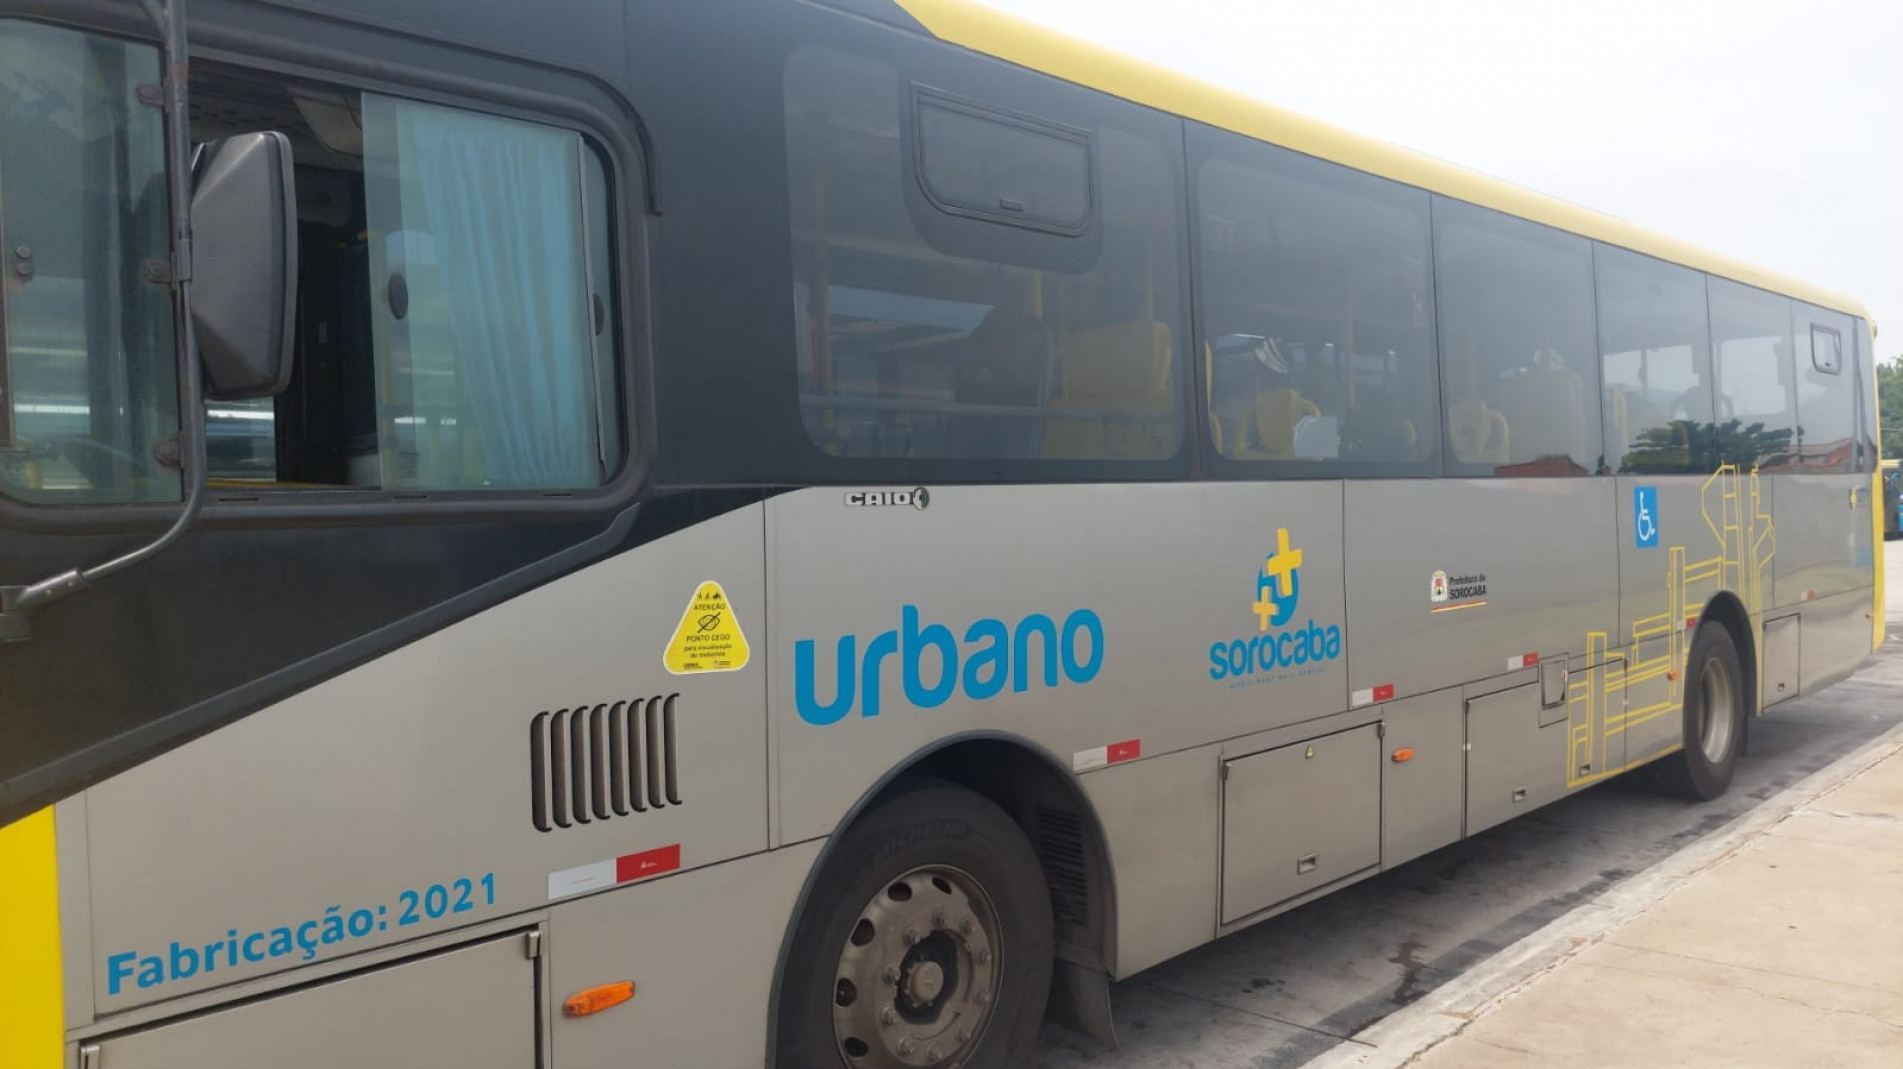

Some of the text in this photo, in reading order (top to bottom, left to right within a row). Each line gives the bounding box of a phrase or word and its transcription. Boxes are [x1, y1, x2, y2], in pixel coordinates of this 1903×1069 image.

[844, 491, 911, 506] CAIO
[1449, 584, 1487, 599] SOROCABA
[686, 633, 731, 642] PONTO CEGO
[1209, 619, 1341, 680] sorocaba
[795, 604, 1104, 726] urbano
[107, 872, 495, 995] Fabricação: 2021
